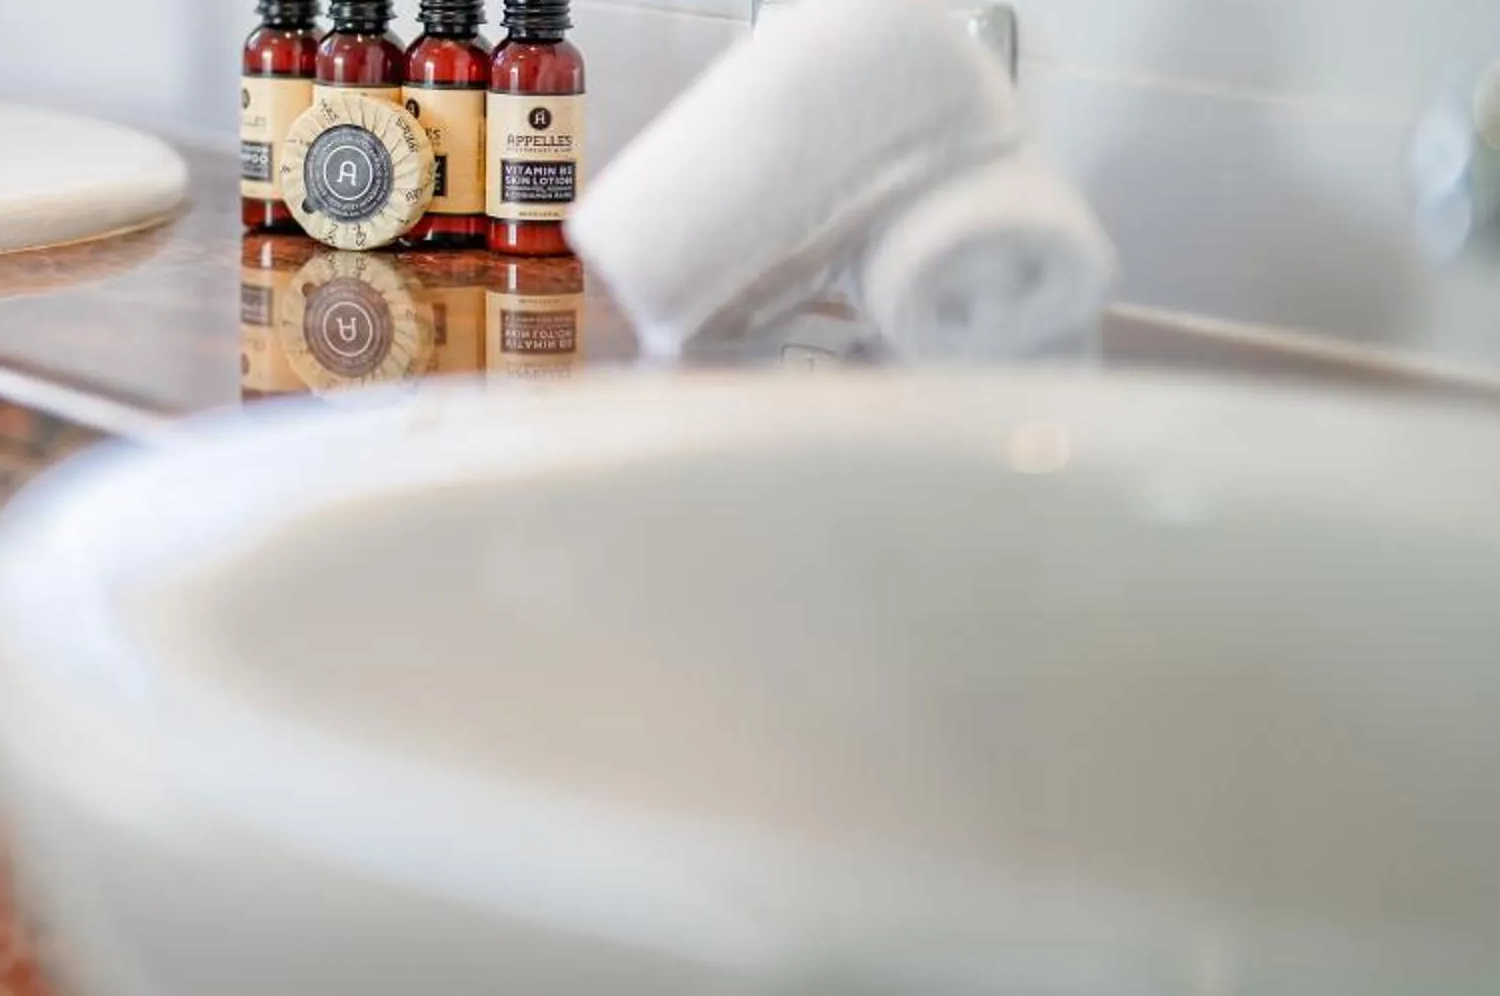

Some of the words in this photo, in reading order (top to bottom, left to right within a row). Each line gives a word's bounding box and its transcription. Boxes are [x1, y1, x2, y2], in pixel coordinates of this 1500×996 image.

[507, 134, 573, 147] APPELLES
[336, 160, 357, 186] A
[505, 165, 557, 176] VITAMIN
[533, 176, 573, 185] LOTION
